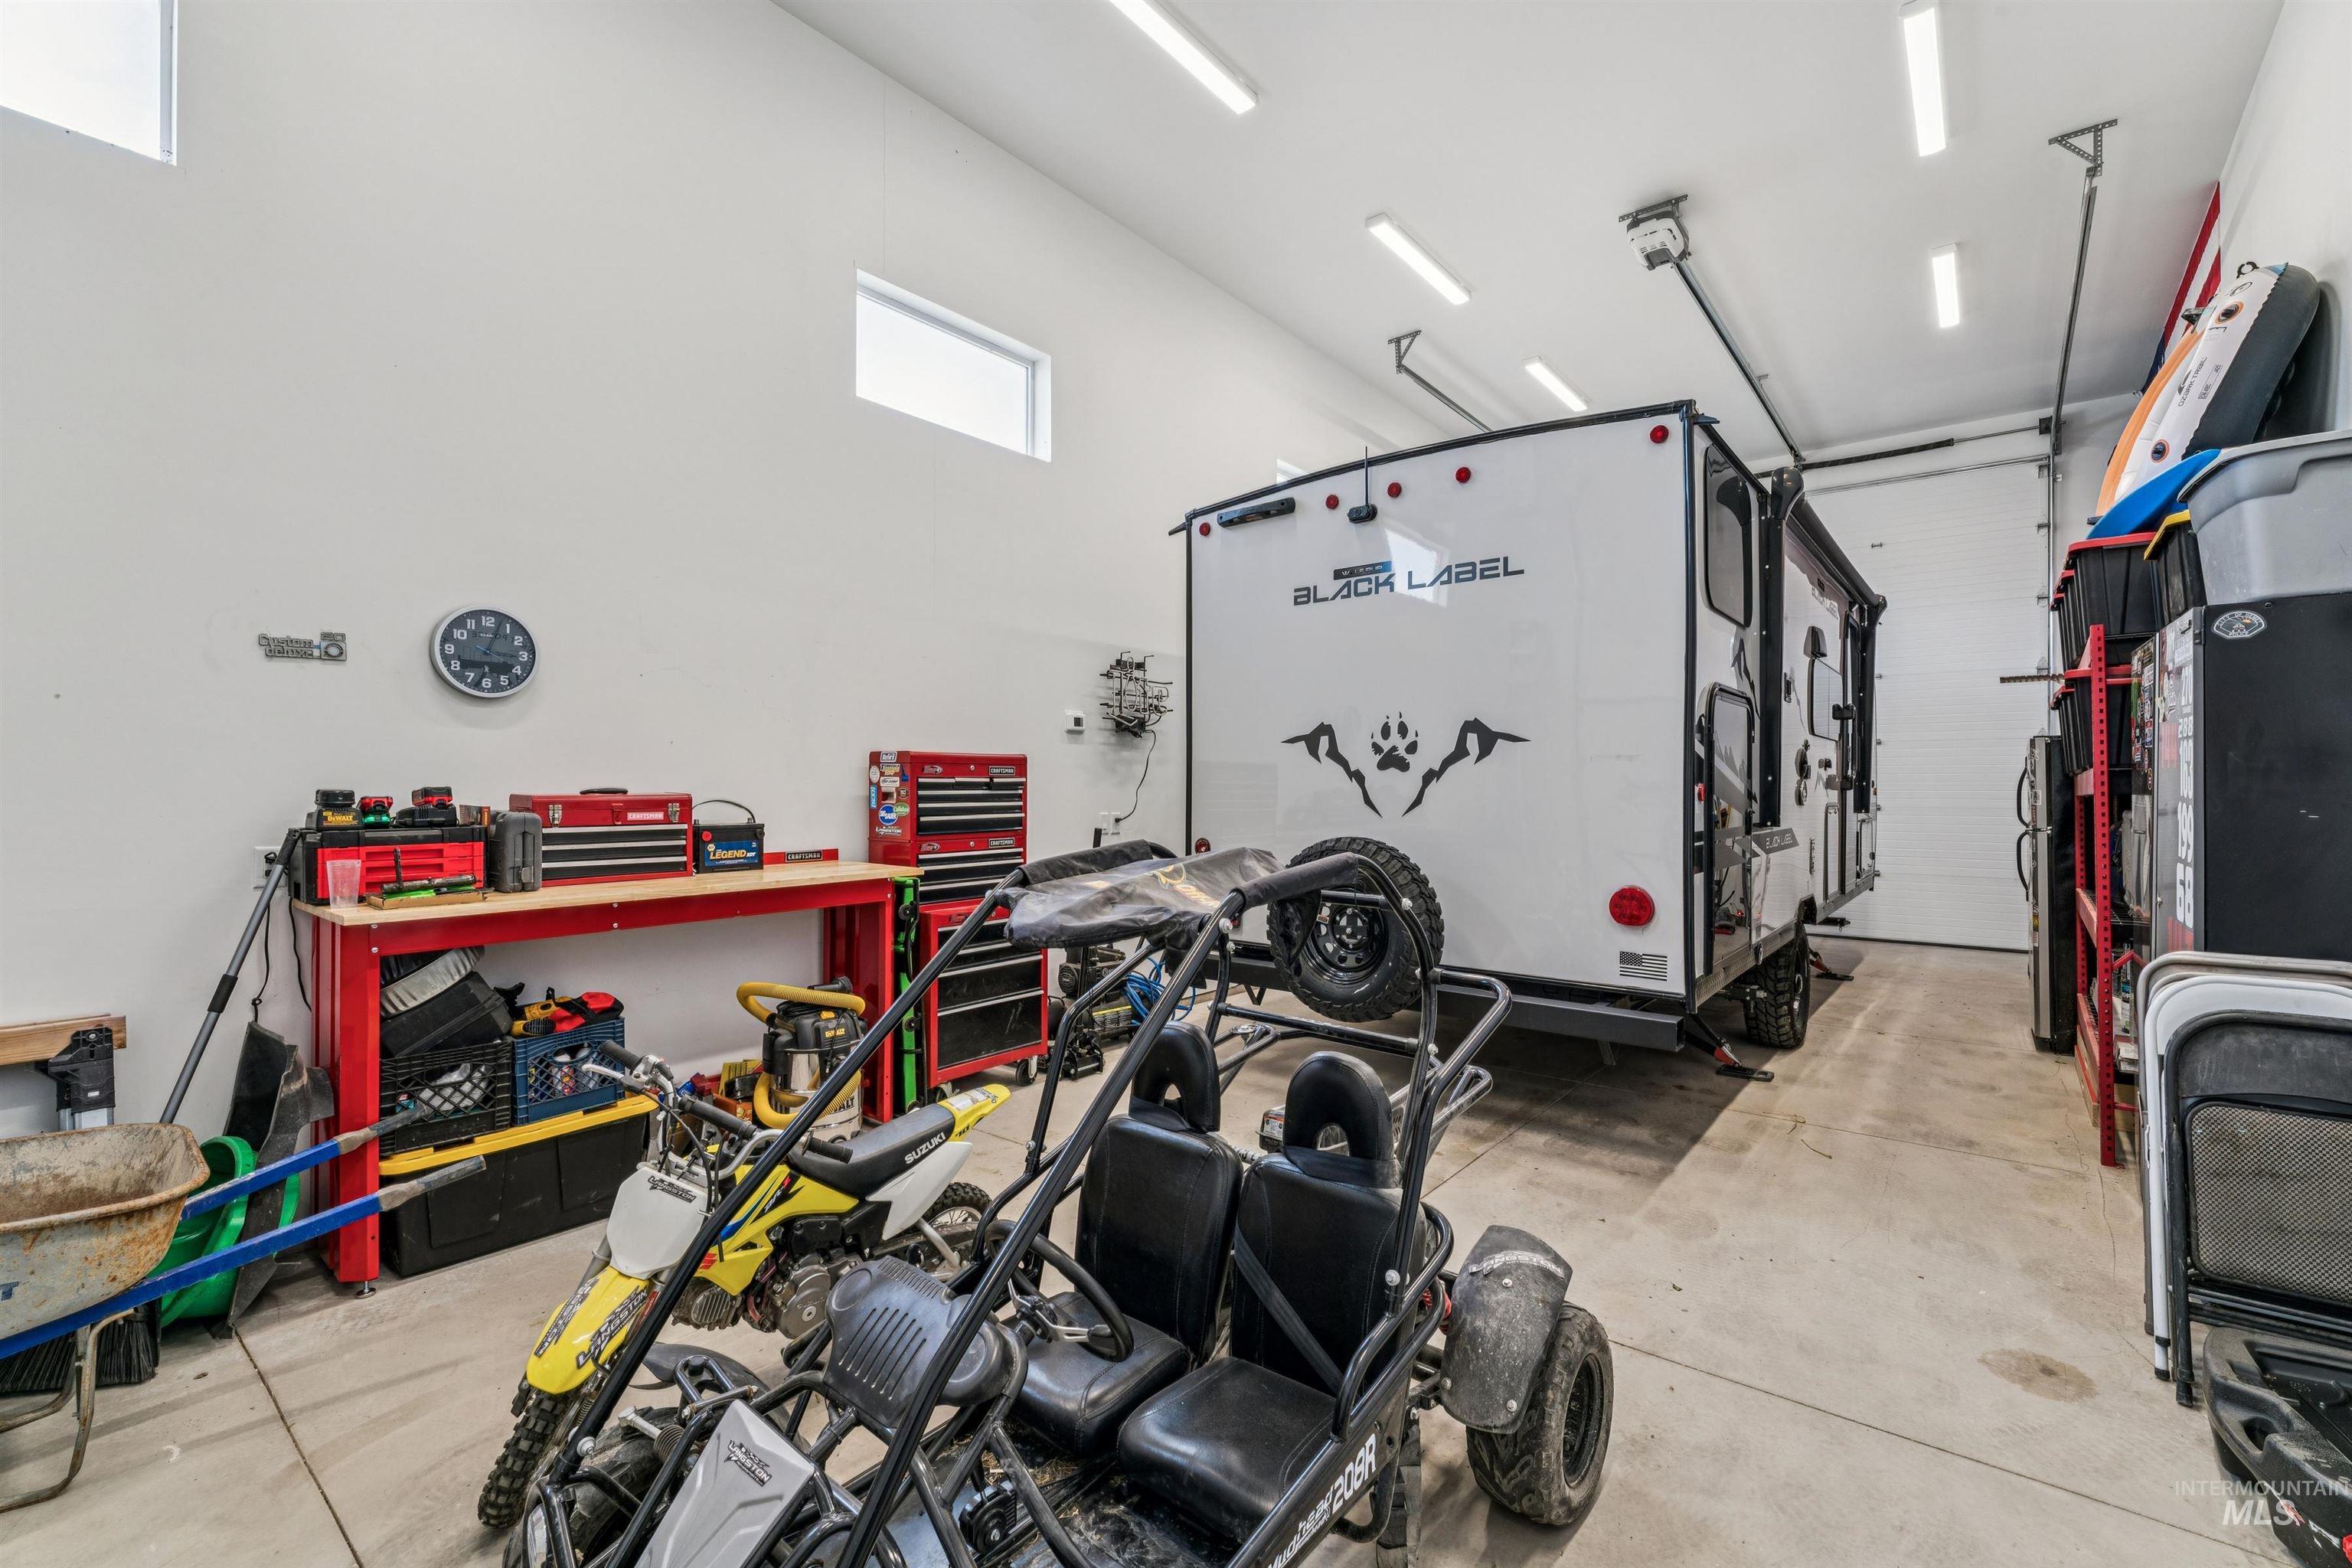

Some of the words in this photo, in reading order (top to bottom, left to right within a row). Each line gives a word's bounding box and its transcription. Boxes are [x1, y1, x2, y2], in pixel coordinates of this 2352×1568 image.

[1293, 573, 1396, 606] BLACK
[1407, 556, 1525, 590] LABEL
[466, 619, 475, 630] 11
[482, 616, 495, 627] 12
[453, 629, 468, 639] 10
[506, 624, 511, 634] 1
[259, 633, 313, 648] Custom
[514, 636, 523, 645] 2
[444, 644, 455, 655] 9
[518, 652, 528, 662] 3
[450, 661, 461, 671] 8
[511, 666, 522, 675] 4
[465, 672, 475, 683] 7
[482, 678, 492, 688] 6
[500, 675, 509, 686] 5
[2181, 663, 2193, 706] 270
[2178, 716, 2193, 738] 288
[2177, 802, 2194, 863] 199
[710, 849, 746, 860] LEGEND
[2177, 862, 2194, 929] 68
[904, 1132, 947, 1165] SUZUKI
[648, 1176, 695, 1200] LANGSTON
[577, 1289, 648, 1369] LANGSTON
[728, 1440, 770, 1481] LANGSTON
[1332, 1432, 1377, 1515] 208R
